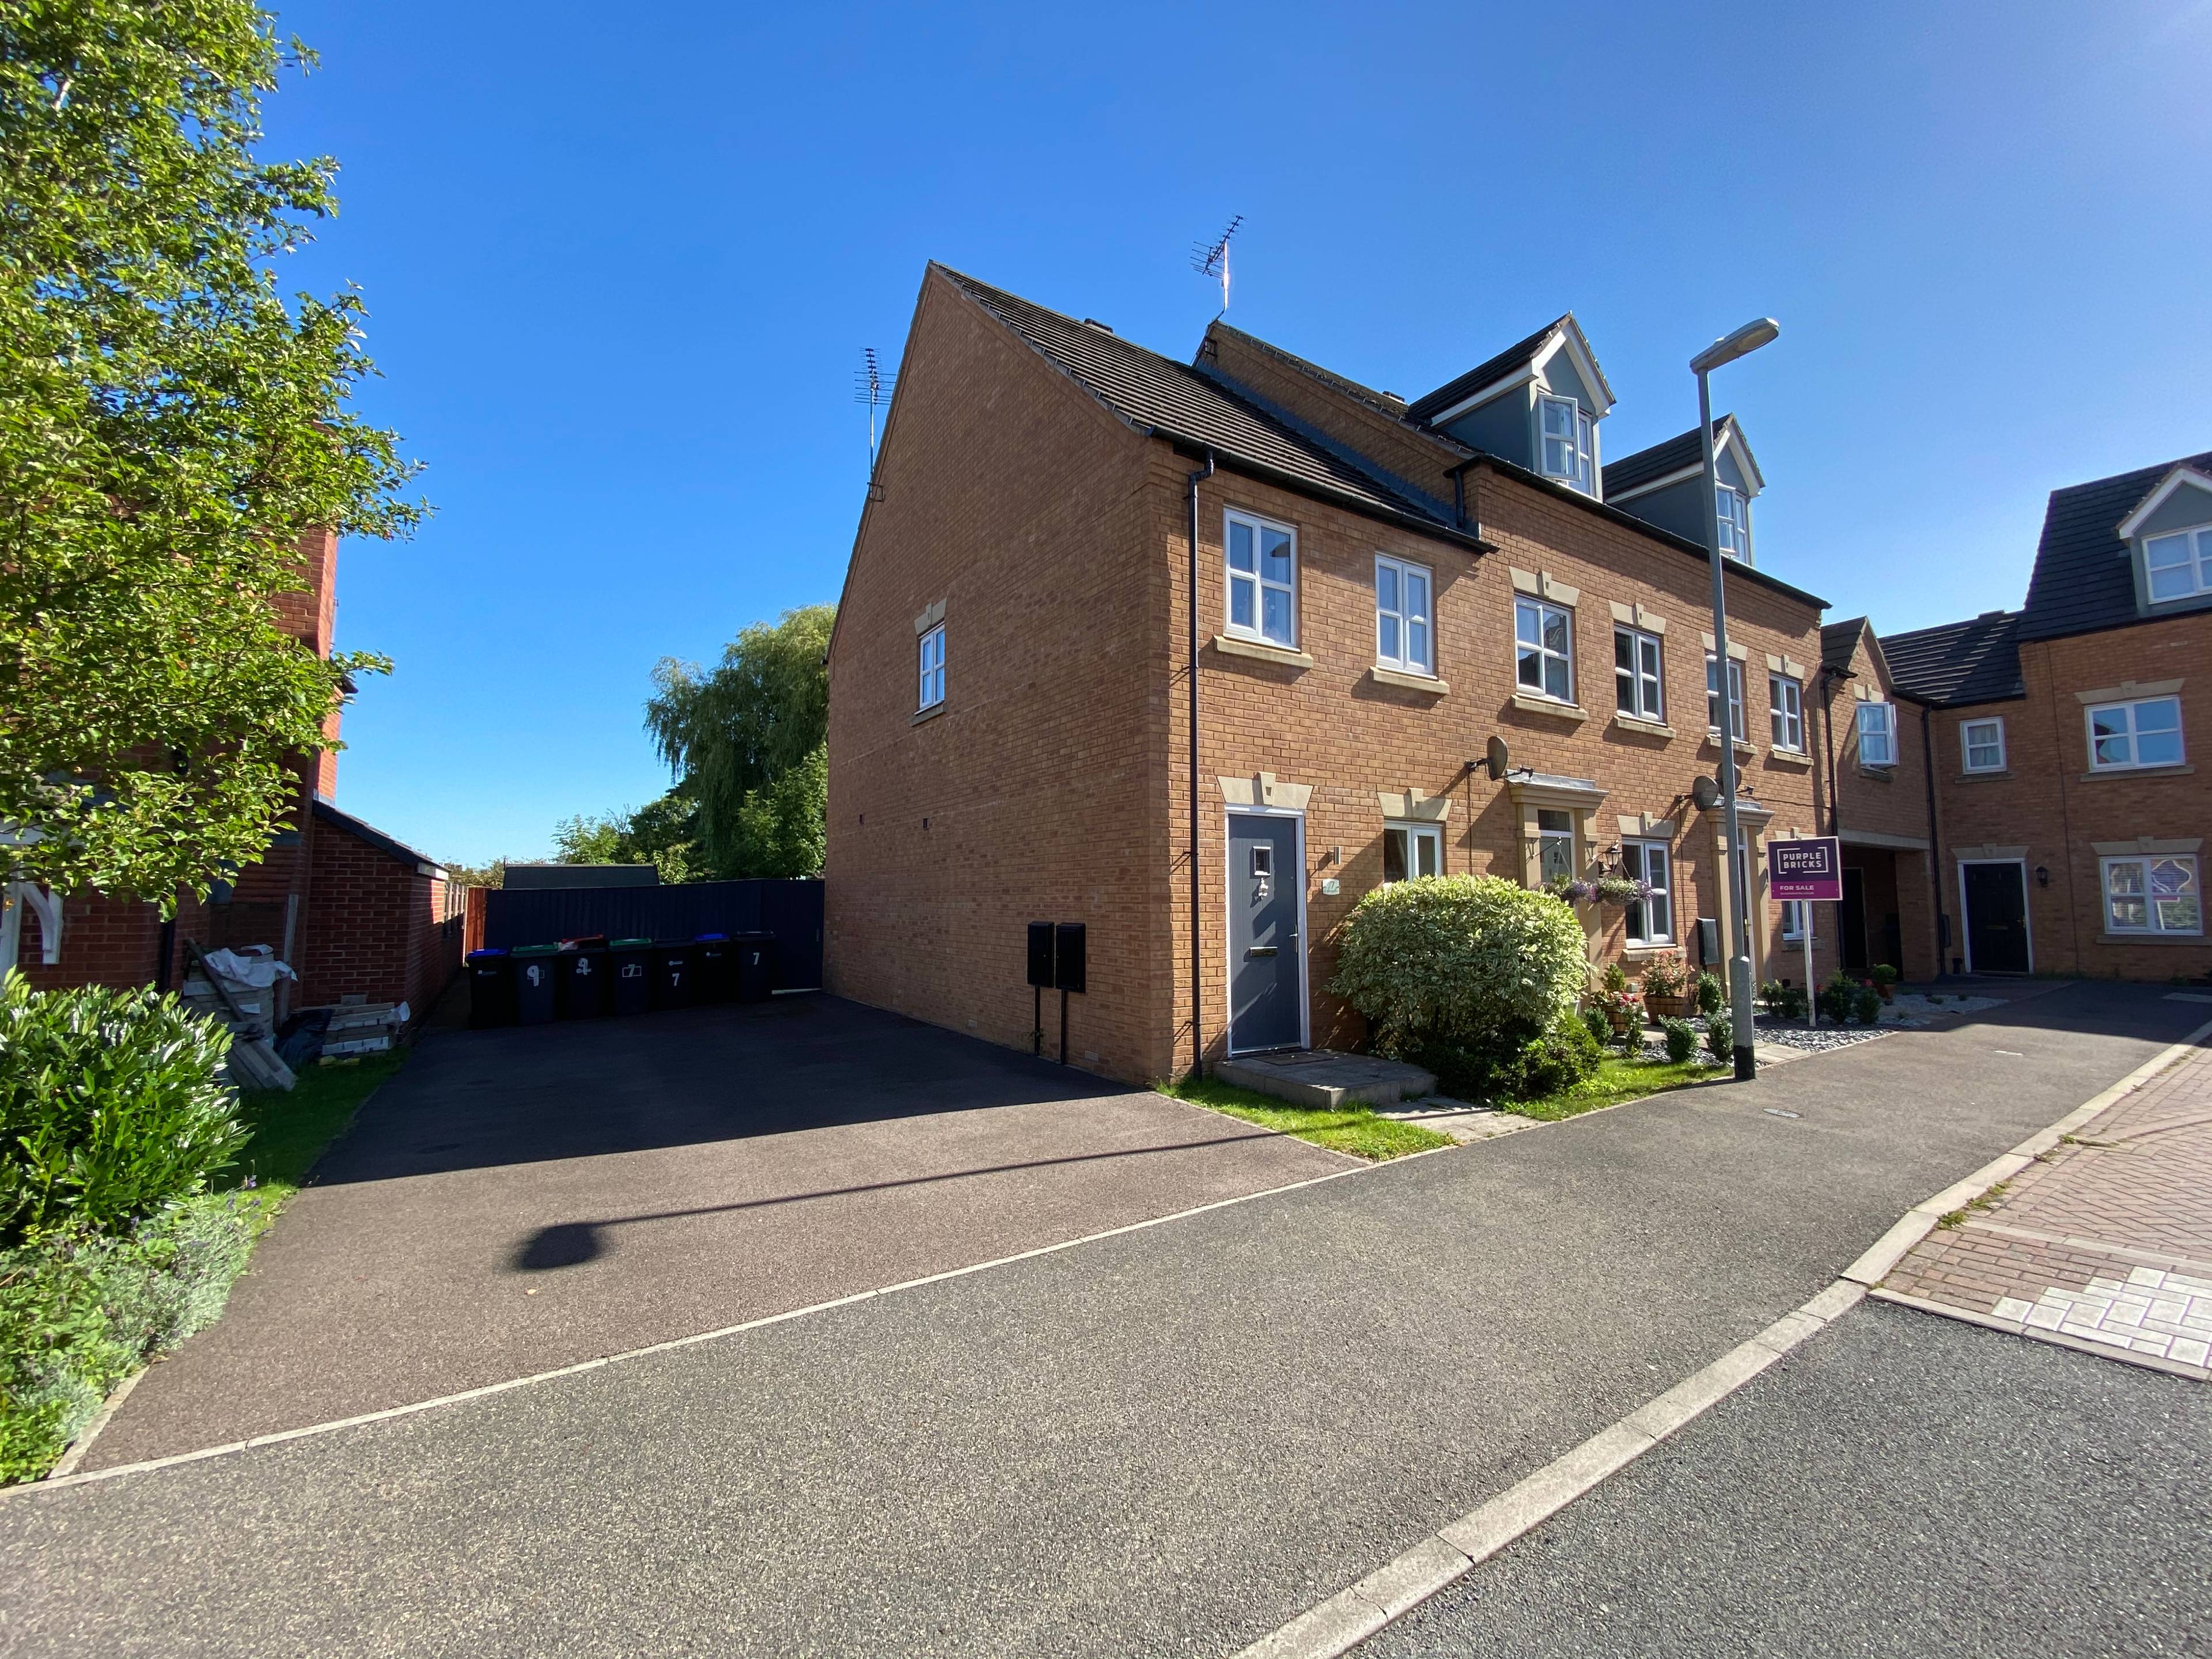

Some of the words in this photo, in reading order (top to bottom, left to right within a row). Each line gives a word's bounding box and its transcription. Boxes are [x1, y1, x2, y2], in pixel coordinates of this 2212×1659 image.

[1783, 853, 1821, 861] PURPLE
[1783, 861, 1822, 869] BRICKS
[752, 952, 760, 965] 7
[527, 965, 540, 987] 9
[672, 972, 680, 987] 7
